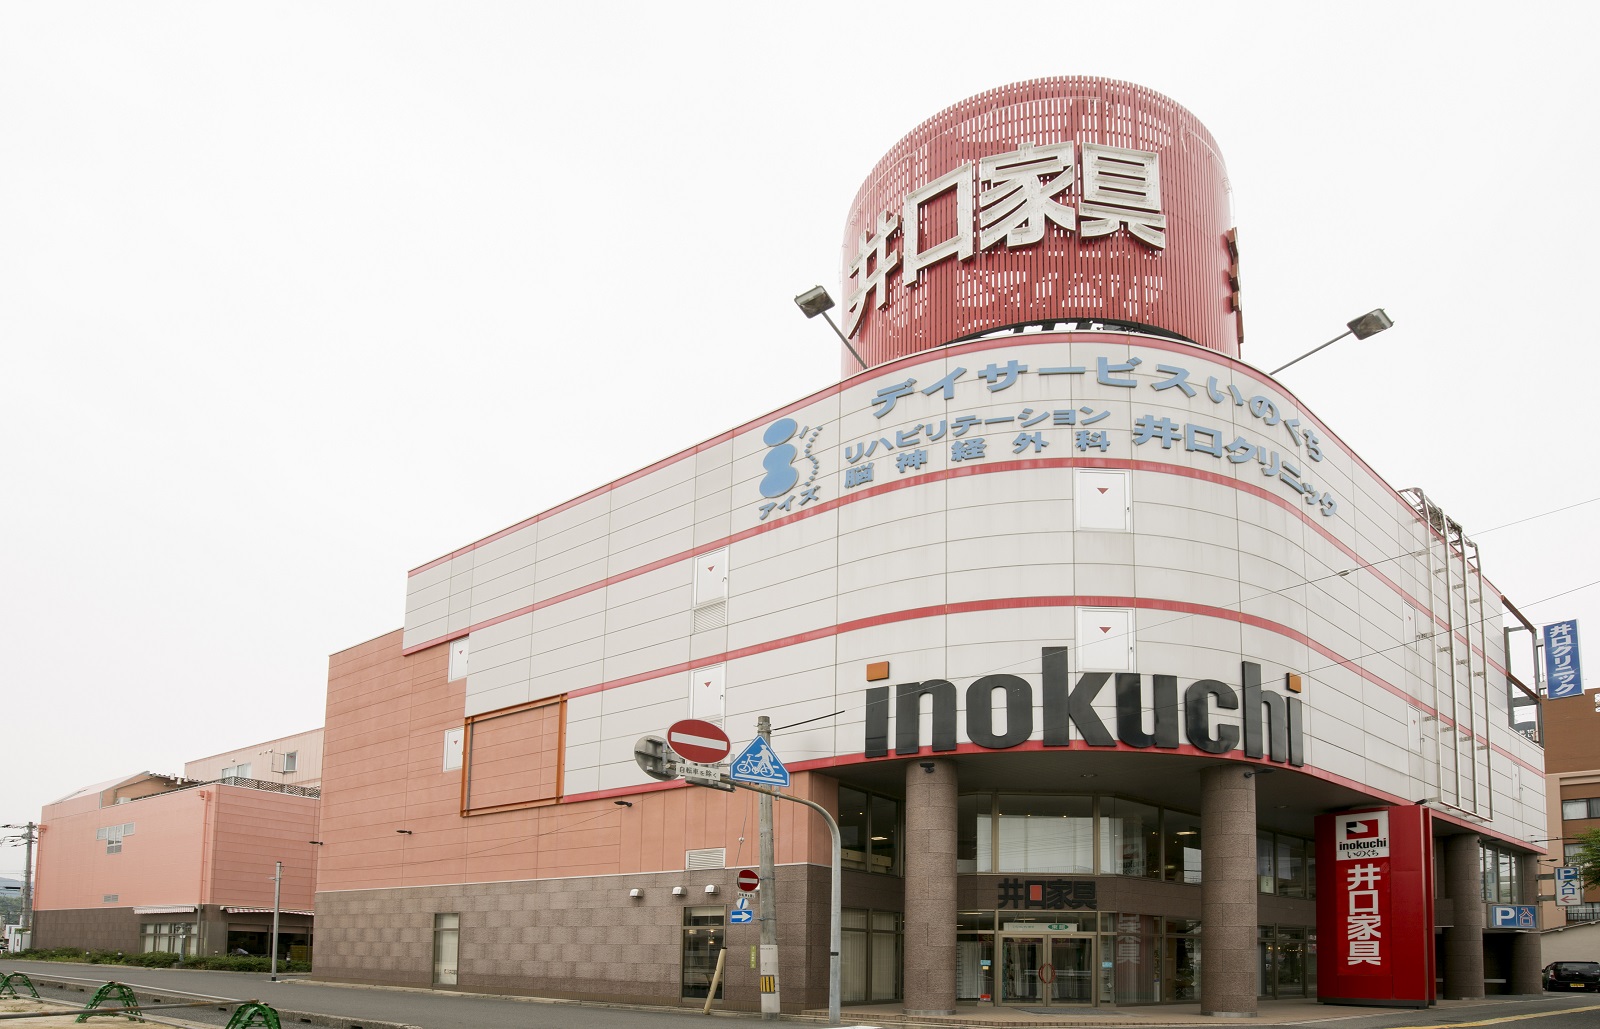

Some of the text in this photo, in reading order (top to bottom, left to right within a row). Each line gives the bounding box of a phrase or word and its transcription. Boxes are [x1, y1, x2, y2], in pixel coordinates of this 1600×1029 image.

[848, 141, 1166, 340] 井口家具
[844, 406, 1111, 464] リハビリテーション
[1133, 414, 1338, 516] 井口クリニック
[759, 485, 821, 520] アイズ
[1549, 623, 1576, 696] 井口クリニック
[865, 646, 1304, 768] inokuchi
[679, 766, 718, 778] 自転車を除く
[1339, 838, 1387, 851] inokuchi
[1347, 849, 1379, 858] いのくち
[1559, 868, 1576, 880] P
[1561, 880, 1576, 896] 入口
[997, 878, 1097, 909] 井口家具
[1347, 863, 1382, 967] 井口家具
[1495, 907, 1534, 927] P 入口
